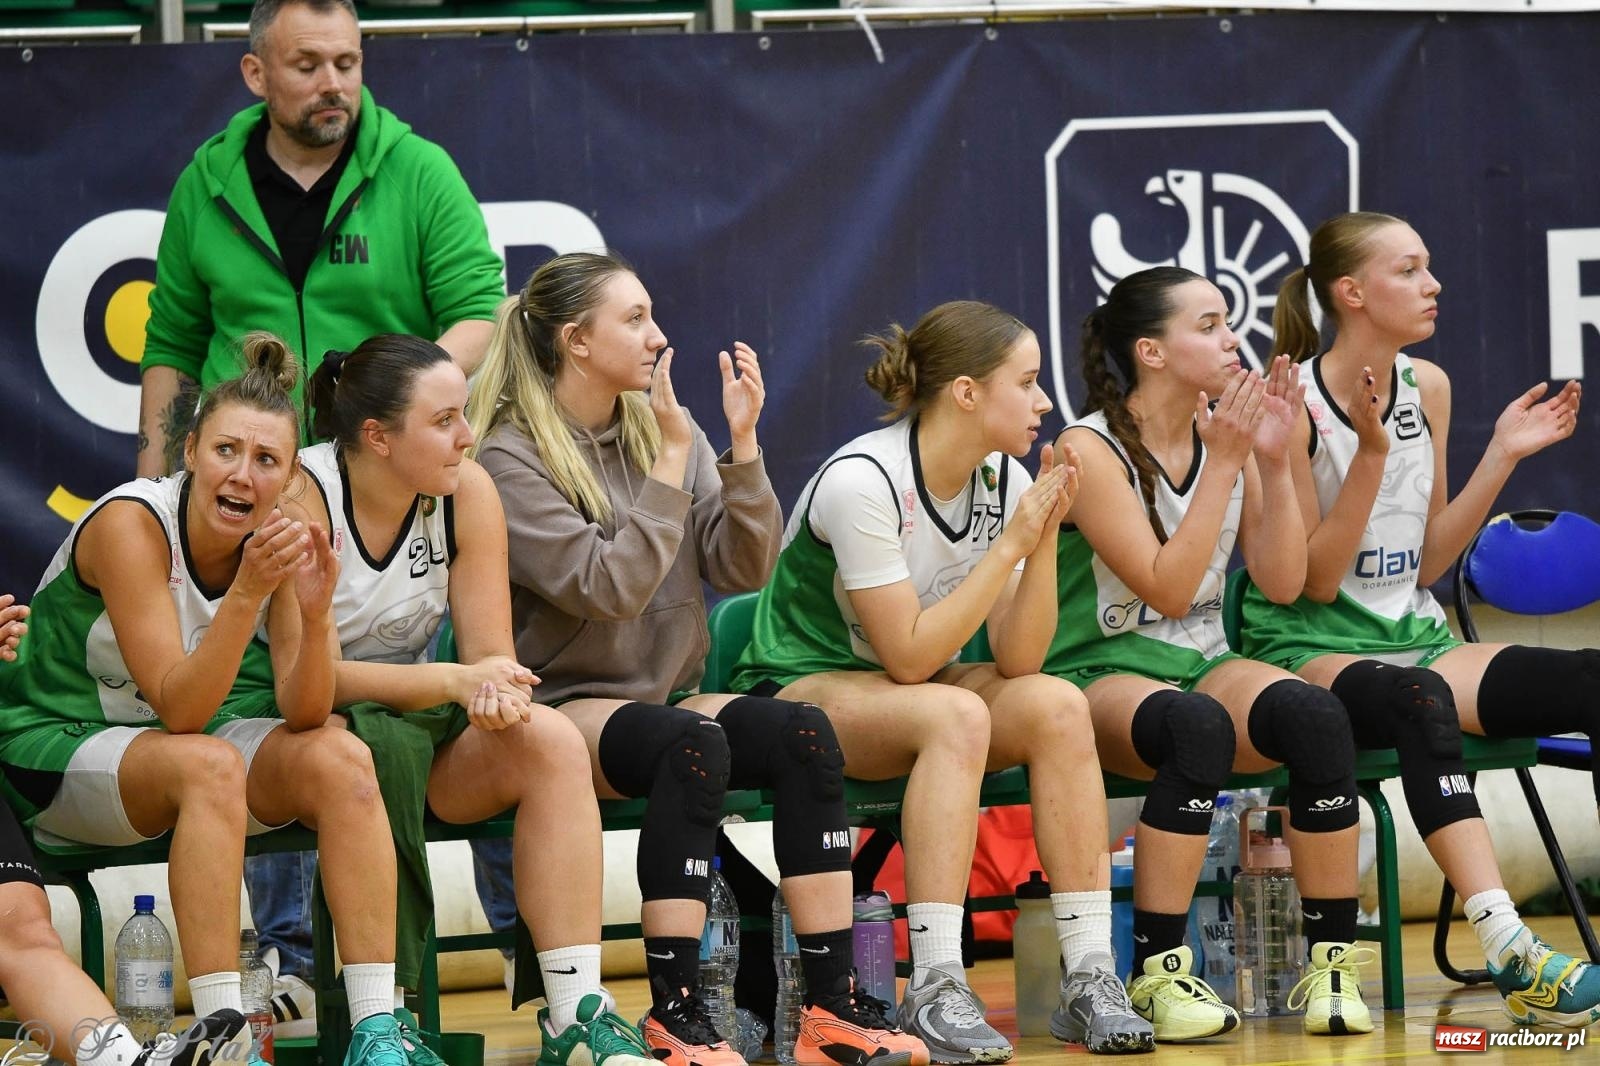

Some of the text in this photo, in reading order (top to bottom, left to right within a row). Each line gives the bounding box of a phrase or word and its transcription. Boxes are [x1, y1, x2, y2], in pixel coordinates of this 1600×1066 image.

[329, 233, 369, 264] GW
[1354, 546, 1421, 578] Clav
[1450, 774, 1472, 794] NBA
[832, 830, 850, 848] NBA
[694, 860, 708, 878] NBA
